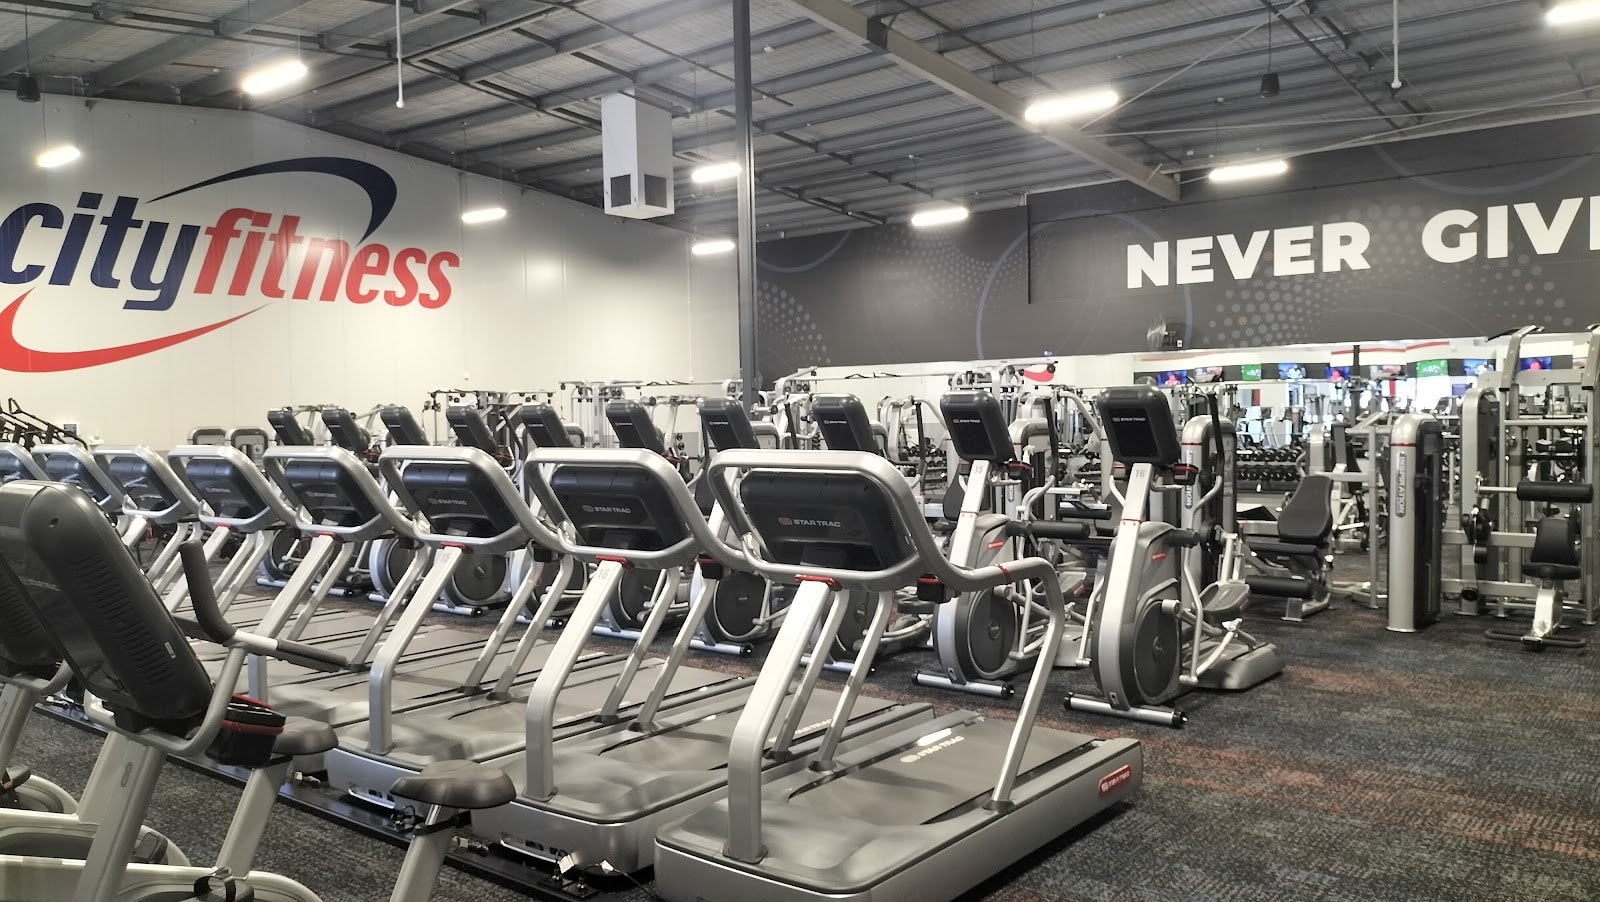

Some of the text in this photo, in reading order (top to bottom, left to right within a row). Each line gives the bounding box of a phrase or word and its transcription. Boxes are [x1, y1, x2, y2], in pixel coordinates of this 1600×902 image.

[0, 191, 460, 311] cityfitness
[1127, 195, 1600, 289] NEVER GIV
[816, 520, 841, 528] TRAC
